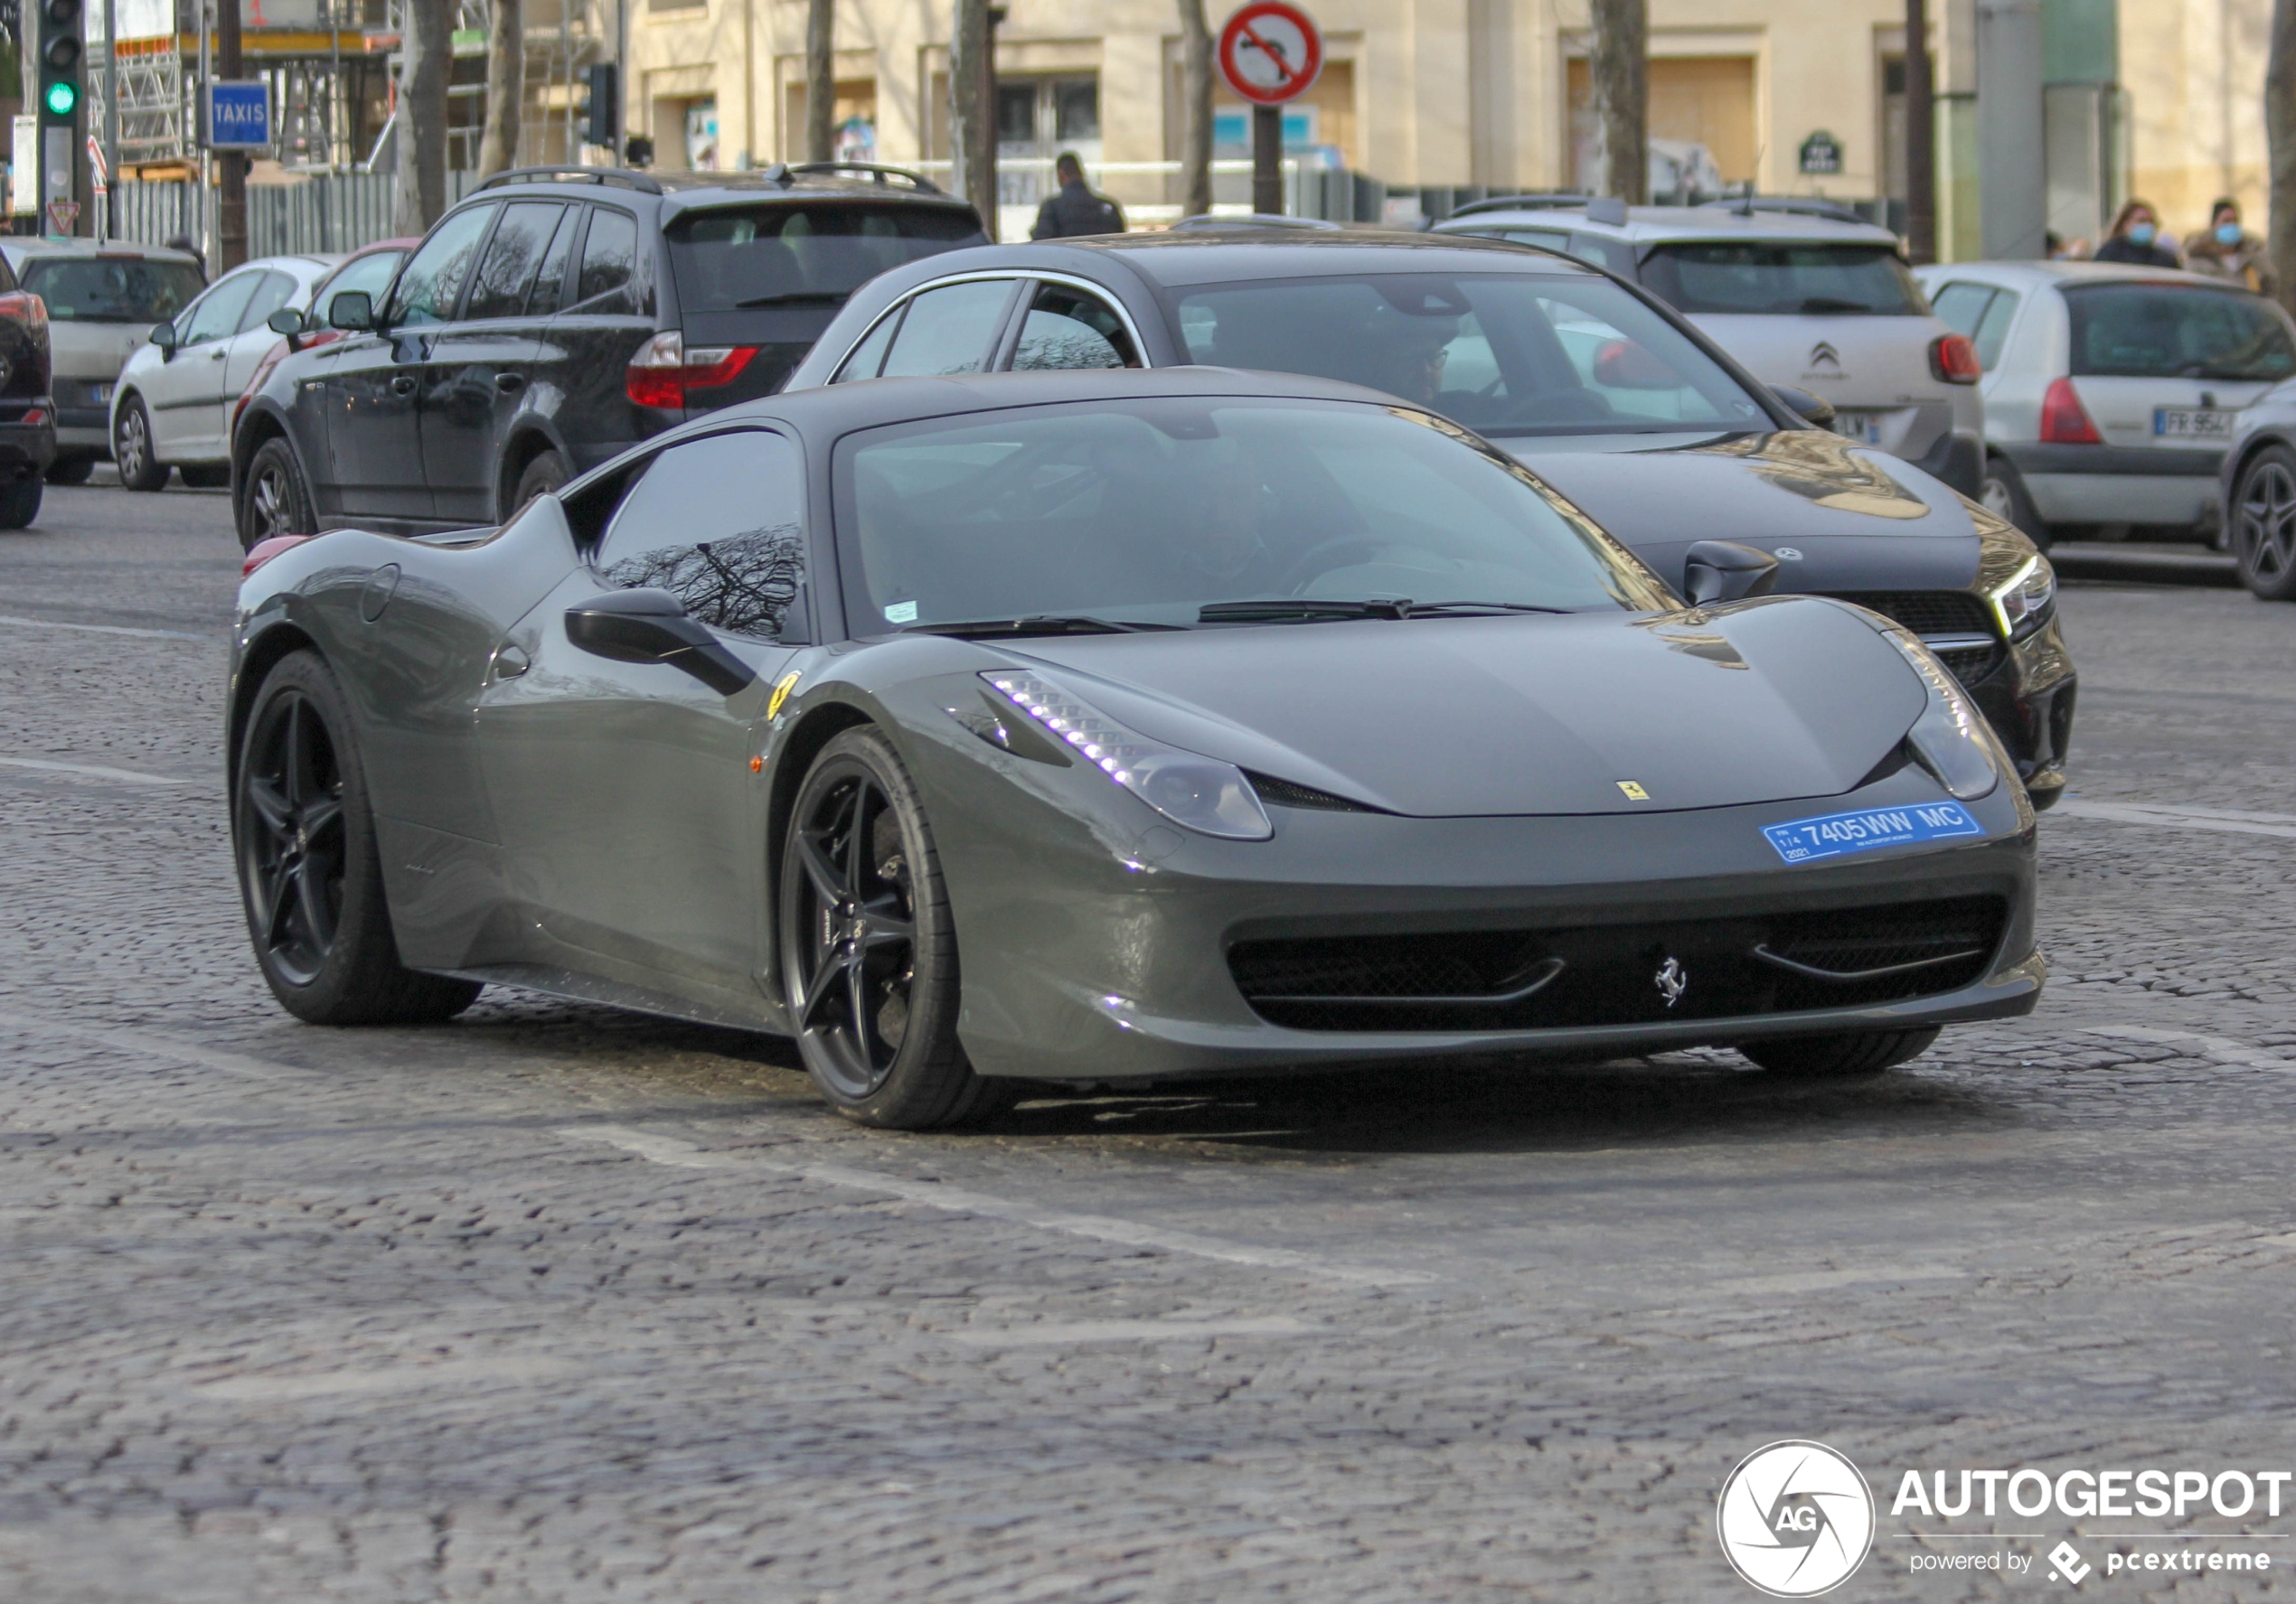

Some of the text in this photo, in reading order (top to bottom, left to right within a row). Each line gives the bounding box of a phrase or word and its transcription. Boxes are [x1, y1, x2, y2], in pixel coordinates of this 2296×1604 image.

[215, 102, 265, 123] TAXIS
[1801, 807, 1964, 846] 7405WW MC
[1786, 847, 1811, 858] 2021
